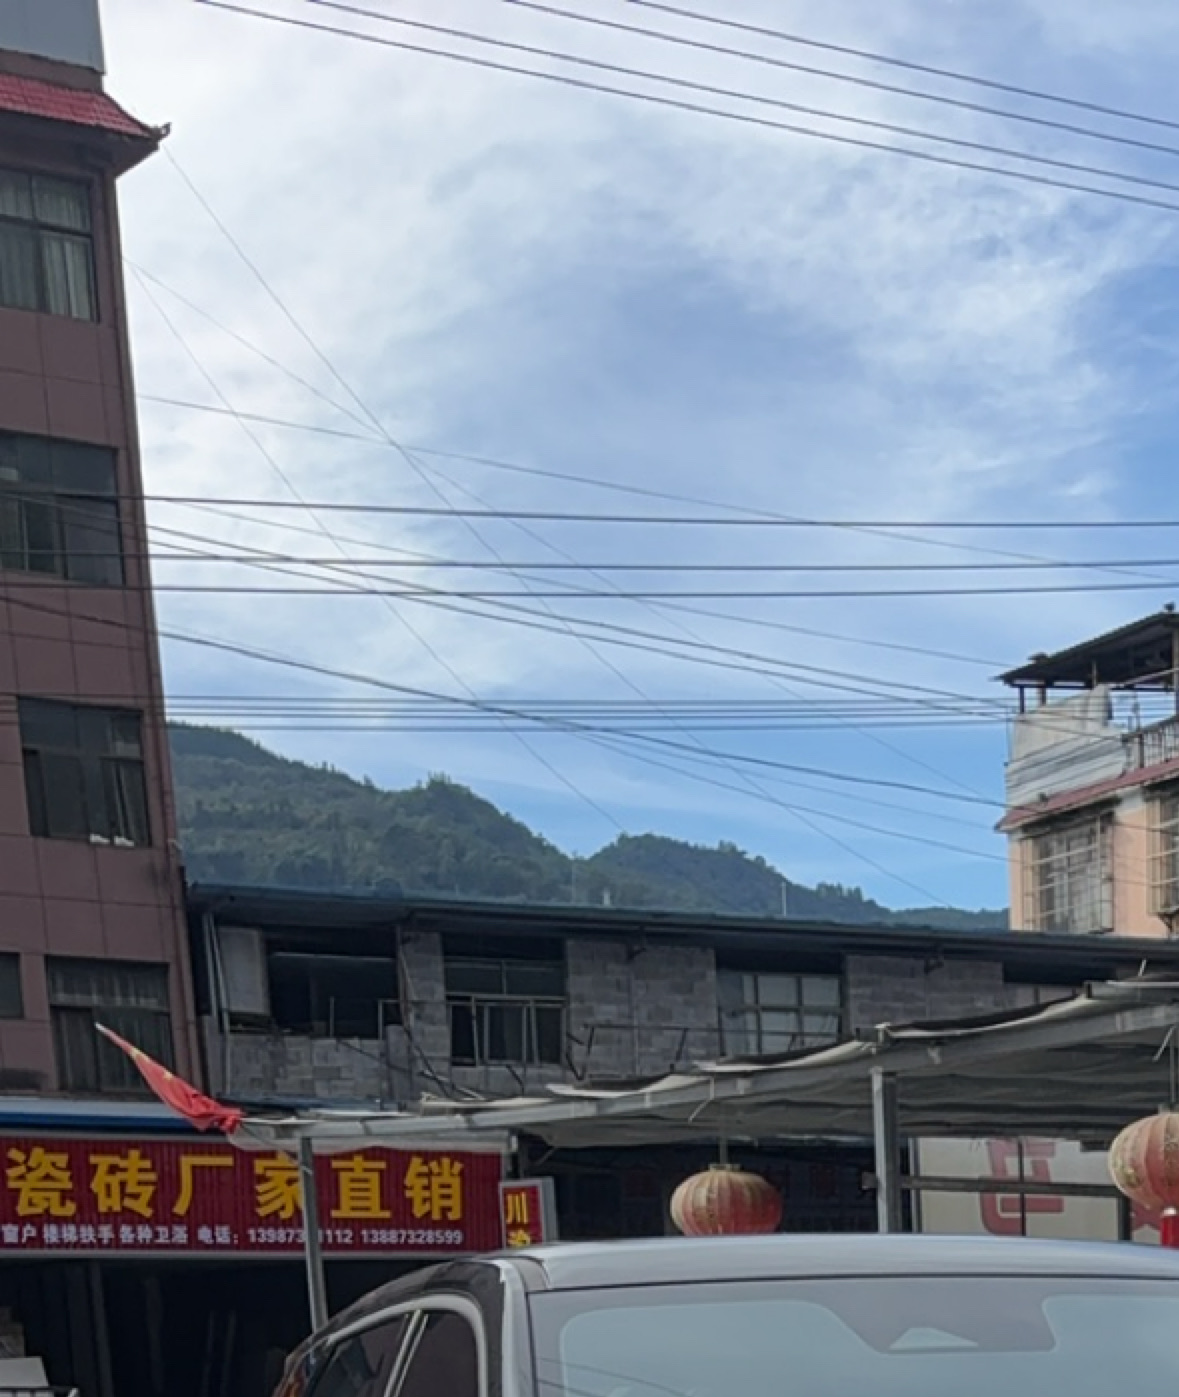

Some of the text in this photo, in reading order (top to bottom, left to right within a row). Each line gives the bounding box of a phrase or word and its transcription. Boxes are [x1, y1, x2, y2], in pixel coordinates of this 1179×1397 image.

[5, 1147, 464, 1221] 瓷砖厂家直销
[120, 1223, 188, 1244] 各种卫浴
[247, 1227, 353, 1244] 139873112
[361, 1227, 463, 1245] 13887328599
